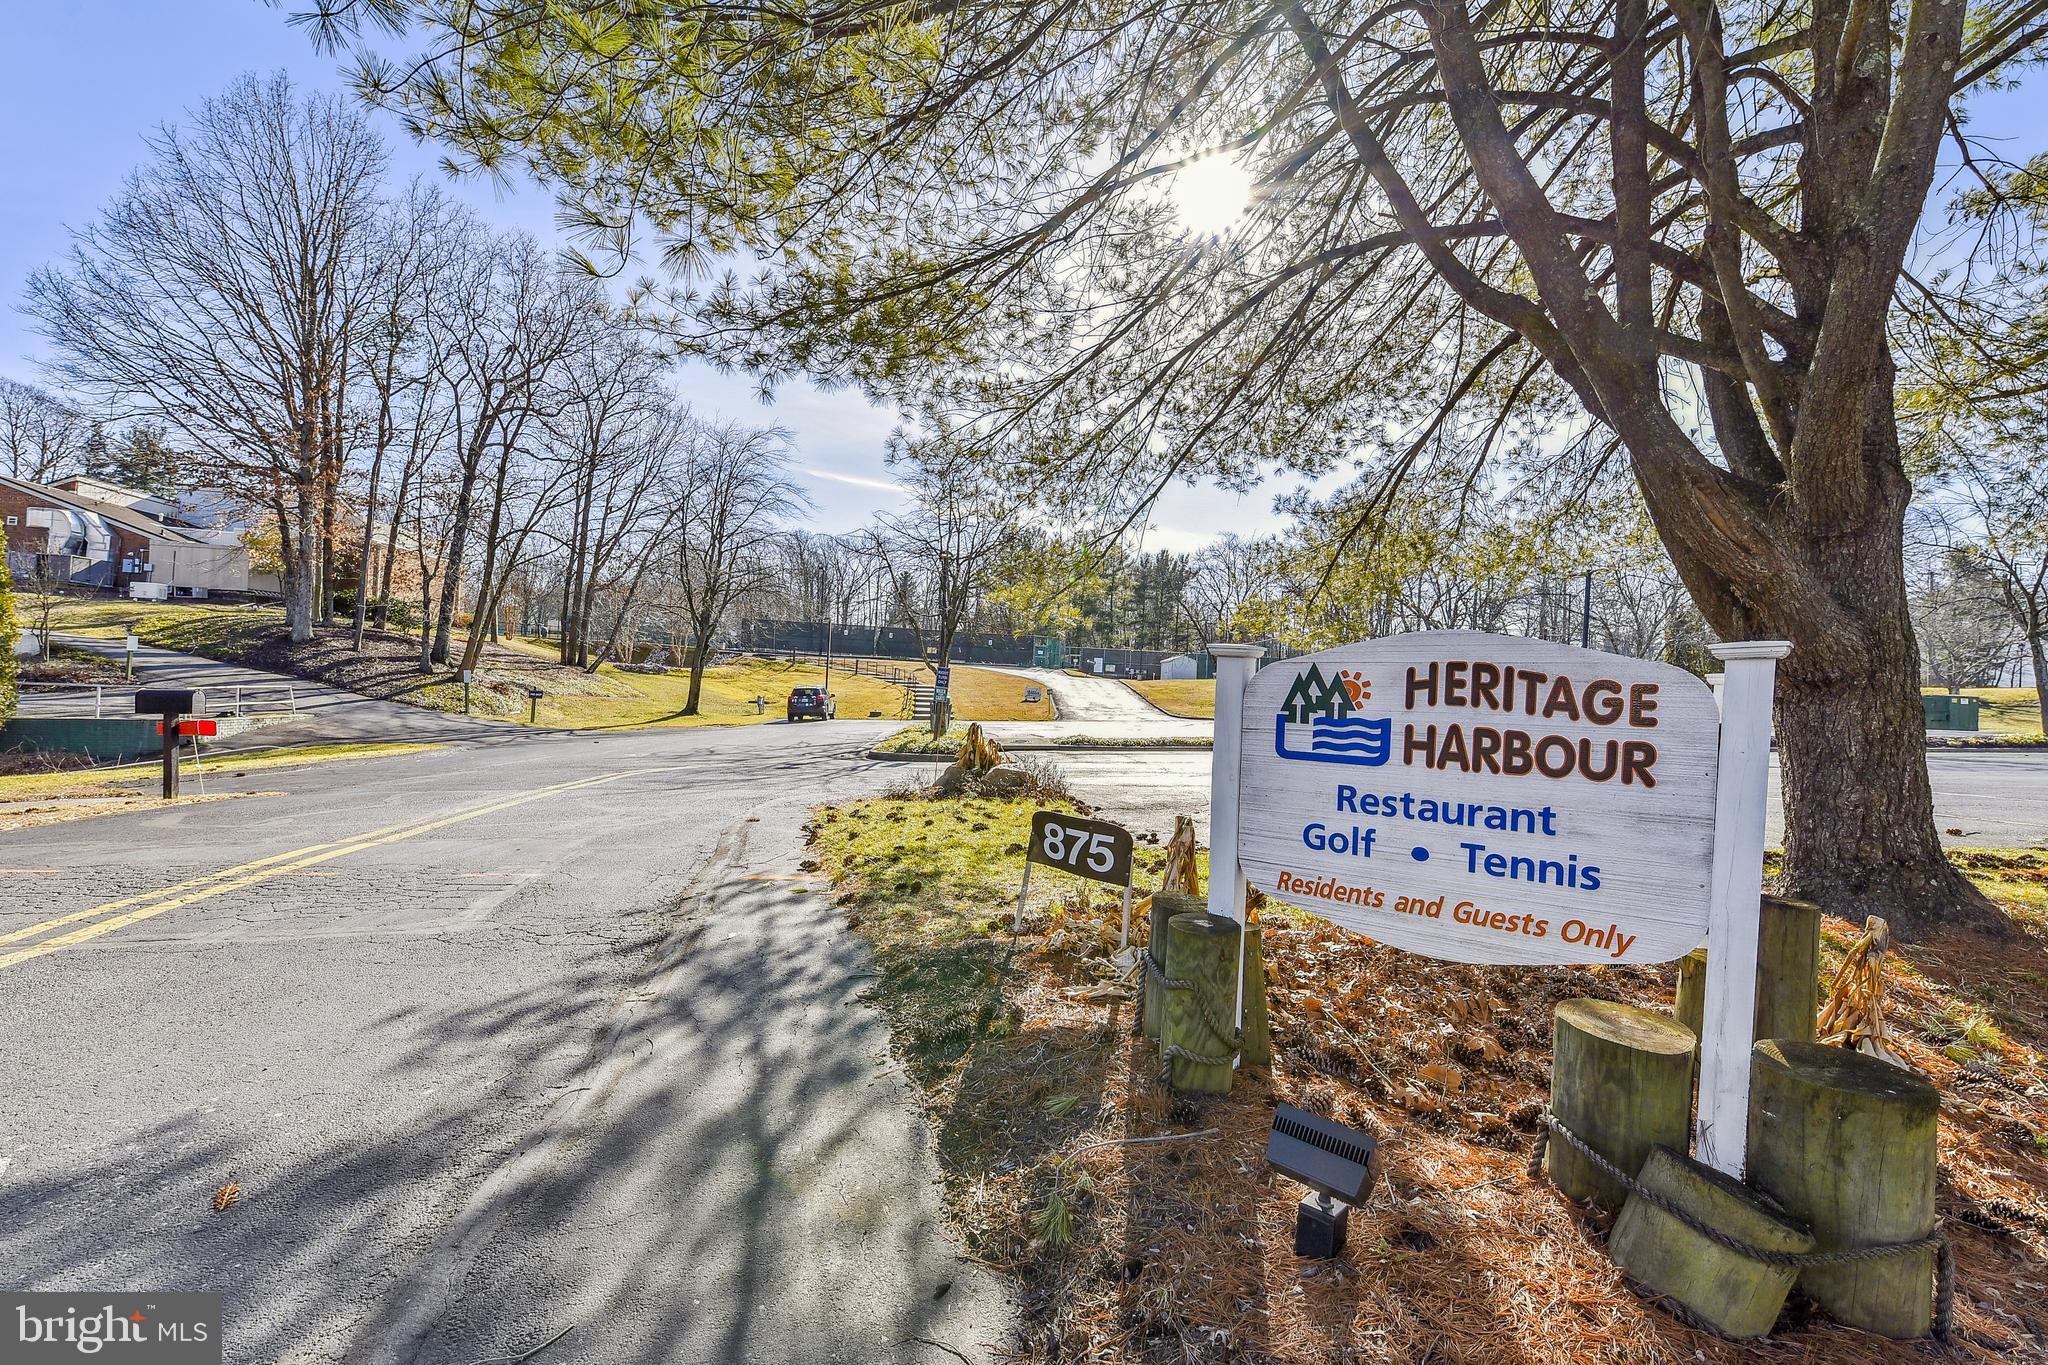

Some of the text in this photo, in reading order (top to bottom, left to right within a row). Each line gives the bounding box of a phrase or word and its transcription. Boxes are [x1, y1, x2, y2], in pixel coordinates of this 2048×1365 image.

[1404, 661, 1661, 728] HERITAGE
[1403, 723, 1658, 789] HARBOUR
[1336, 784, 1557, 836] Restaurant
[1043, 822, 1115, 873] 875
[1302, 823, 1601, 891] Golf Tennis
[1277, 870, 1637, 958] Residents and Guests Only
